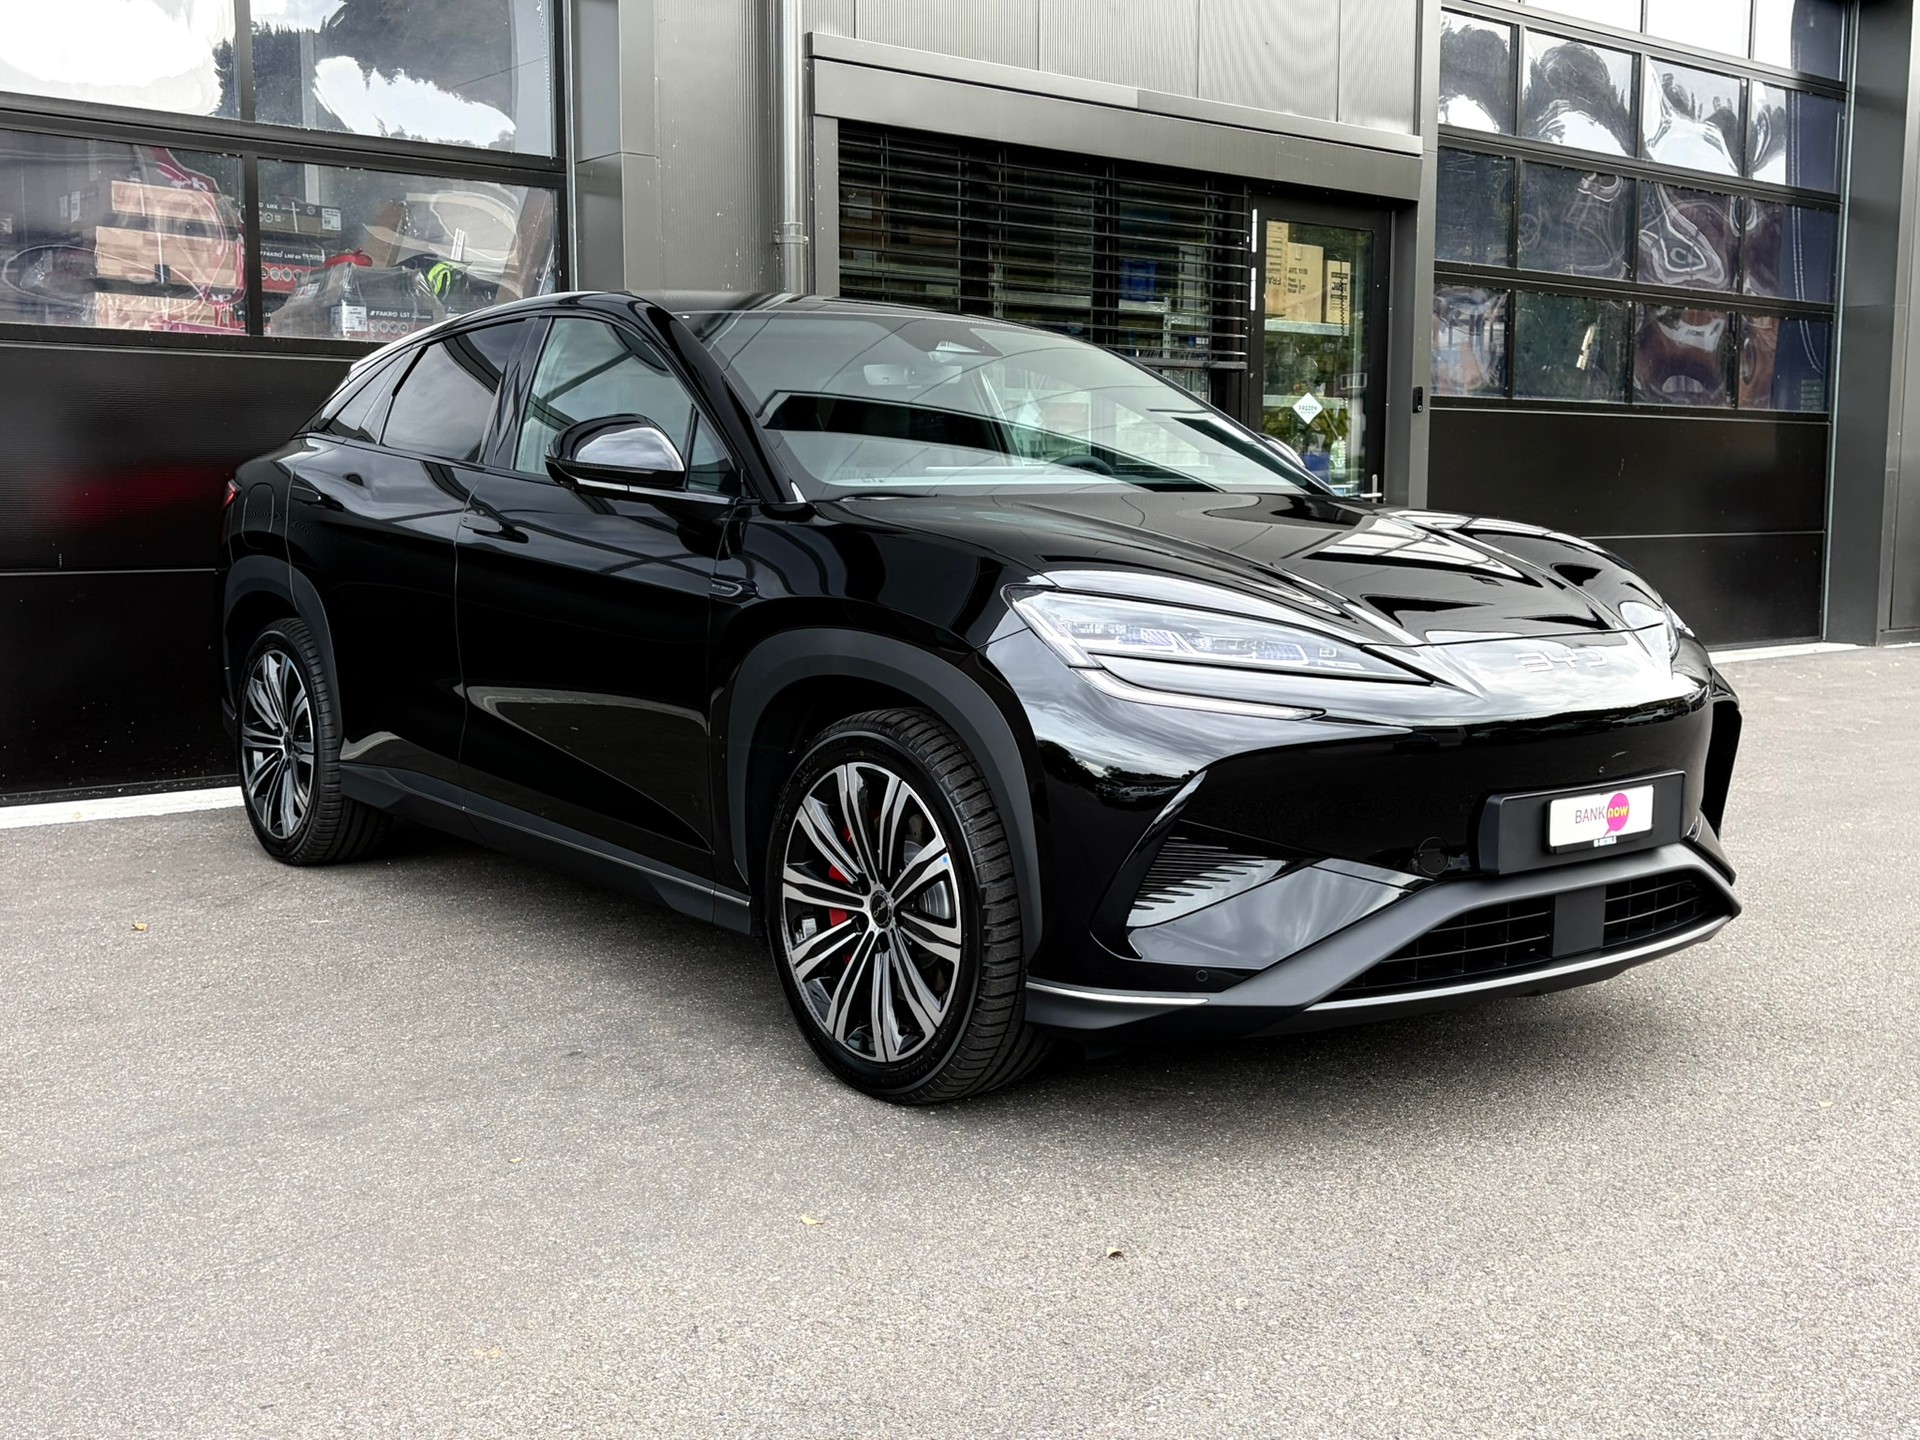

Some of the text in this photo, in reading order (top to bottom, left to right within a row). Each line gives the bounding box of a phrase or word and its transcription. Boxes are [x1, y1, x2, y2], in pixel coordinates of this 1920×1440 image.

[375, 310, 398, 318] FAKRO
[1514, 647, 1608, 673] BYD
[1575, 805, 1629, 824] BANK now
